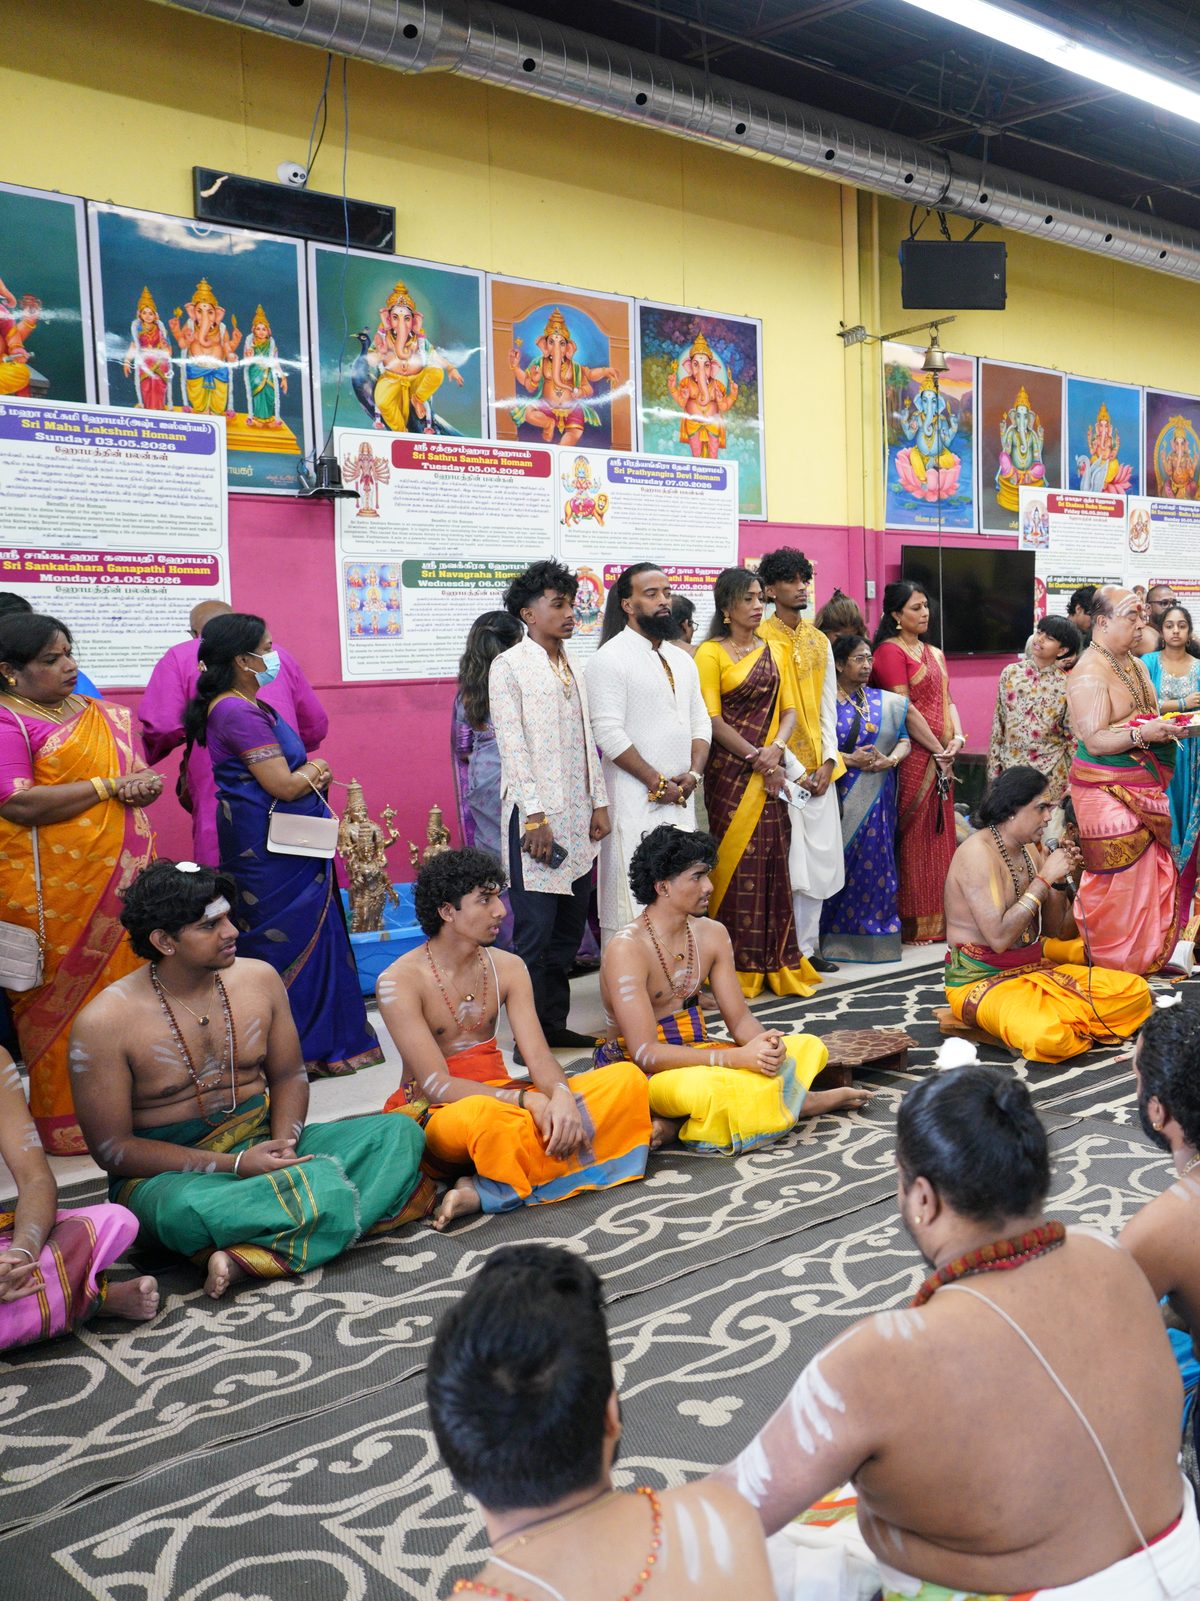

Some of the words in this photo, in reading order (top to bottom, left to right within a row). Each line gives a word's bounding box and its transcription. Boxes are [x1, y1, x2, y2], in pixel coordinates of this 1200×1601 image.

[21, 419, 40, 429] Sri
[44, 421, 81, 432] Maha
[84, 424, 138, 437] Lakshmi
[142, 429, 187, 441] Homam
[35, 432, 91, 446] Sunday
[95, 437, 176, 451] 03.05.2026
[412, 451, 425, 460] Sri
[427, 452, 458, 462] Sathru
[459, 455, 498, 465] Samhara
[500, 457, 533, 467] Homam
[421, 462, 466, 473] Tuesday
[468, 465, 525, 475] 05.05.2026
[627, 468, 675, 479] Prathyangira
[676, 472, 692, 480] Devi
[694, 473, 721, 481] Homam
[624, 476, 664, 487] Thursday
[103, 554, 154, 564] கணபதி
[157, 555, 215, 565] ஹோமம்
[2, 561, 21, 570] Sri
[24, 561, 104, 572] Sankatahara
[107, 563, 166, 575] Ganapathi
[168, 565, 211, 575] Homam
[39, 573, 97, 584] Monday
[101, 575, 181, 584] 04.05.2026
[421, 570, 436, 578] Sri
[438, 570, 492, 579] Navagraha
[605, 573, 616, 581] Sri
[417, 579, 477, 588] Wednesday
